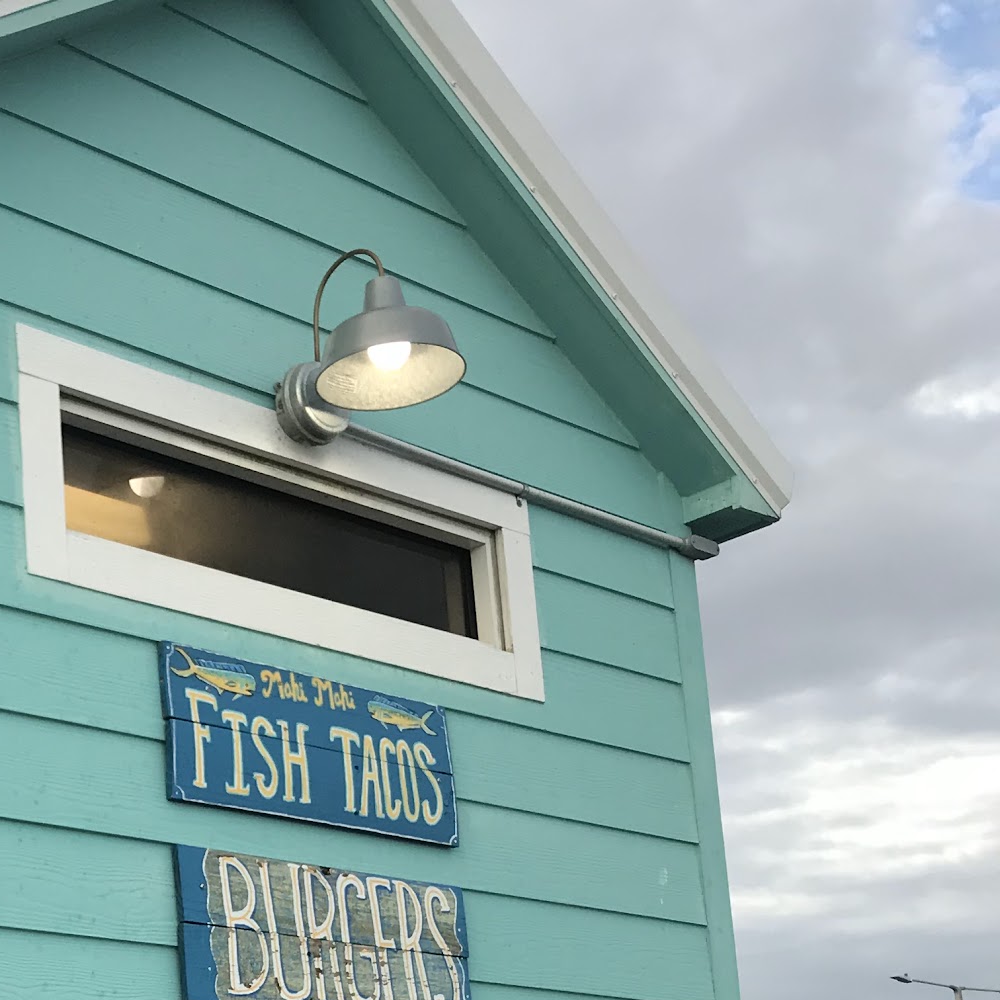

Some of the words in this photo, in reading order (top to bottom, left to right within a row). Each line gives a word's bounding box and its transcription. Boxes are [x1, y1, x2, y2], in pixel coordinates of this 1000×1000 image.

[260, 669, 308, 702] Mahi
[311, 676, 356, 711] Mahi
[185, 687, 311, 804] FISH
[330, 726, 443, 826] TACOS
